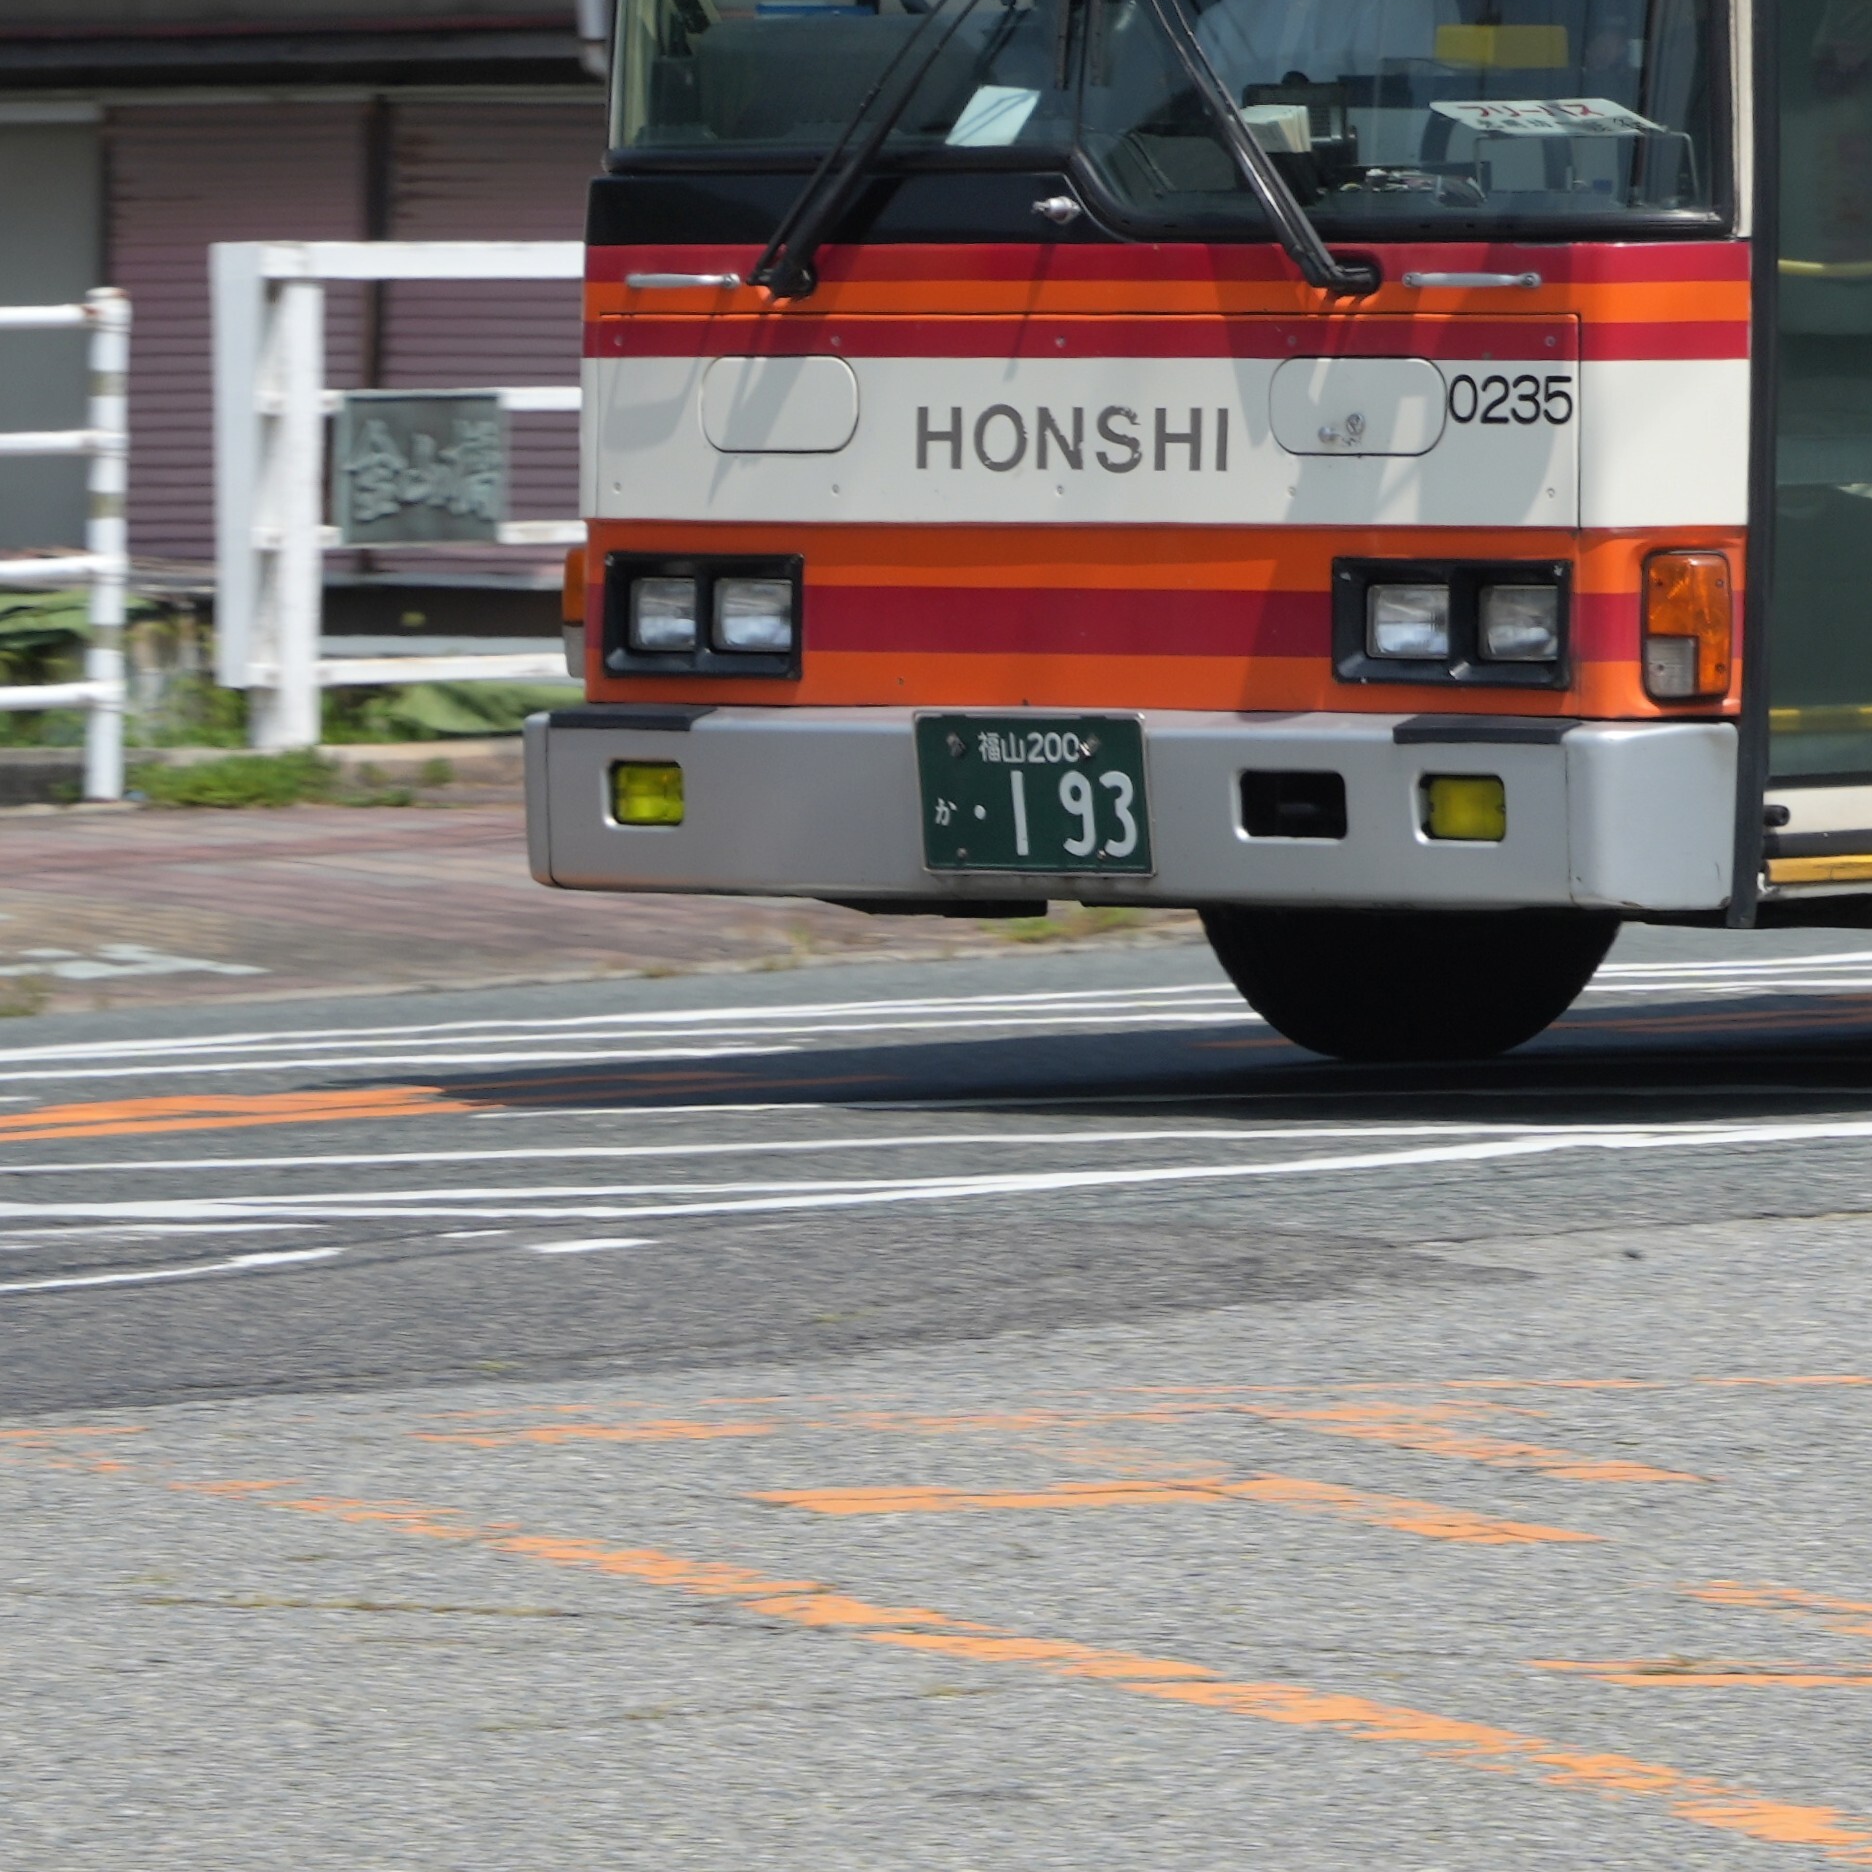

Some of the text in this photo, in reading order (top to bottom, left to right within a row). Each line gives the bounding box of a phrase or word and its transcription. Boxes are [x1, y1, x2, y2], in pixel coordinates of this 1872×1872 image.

[1457, 103, 1605, 118] フリーバス
[1448, 374, 1573, 425] 0235
[915, 403, 1230, 473] HONSHI
